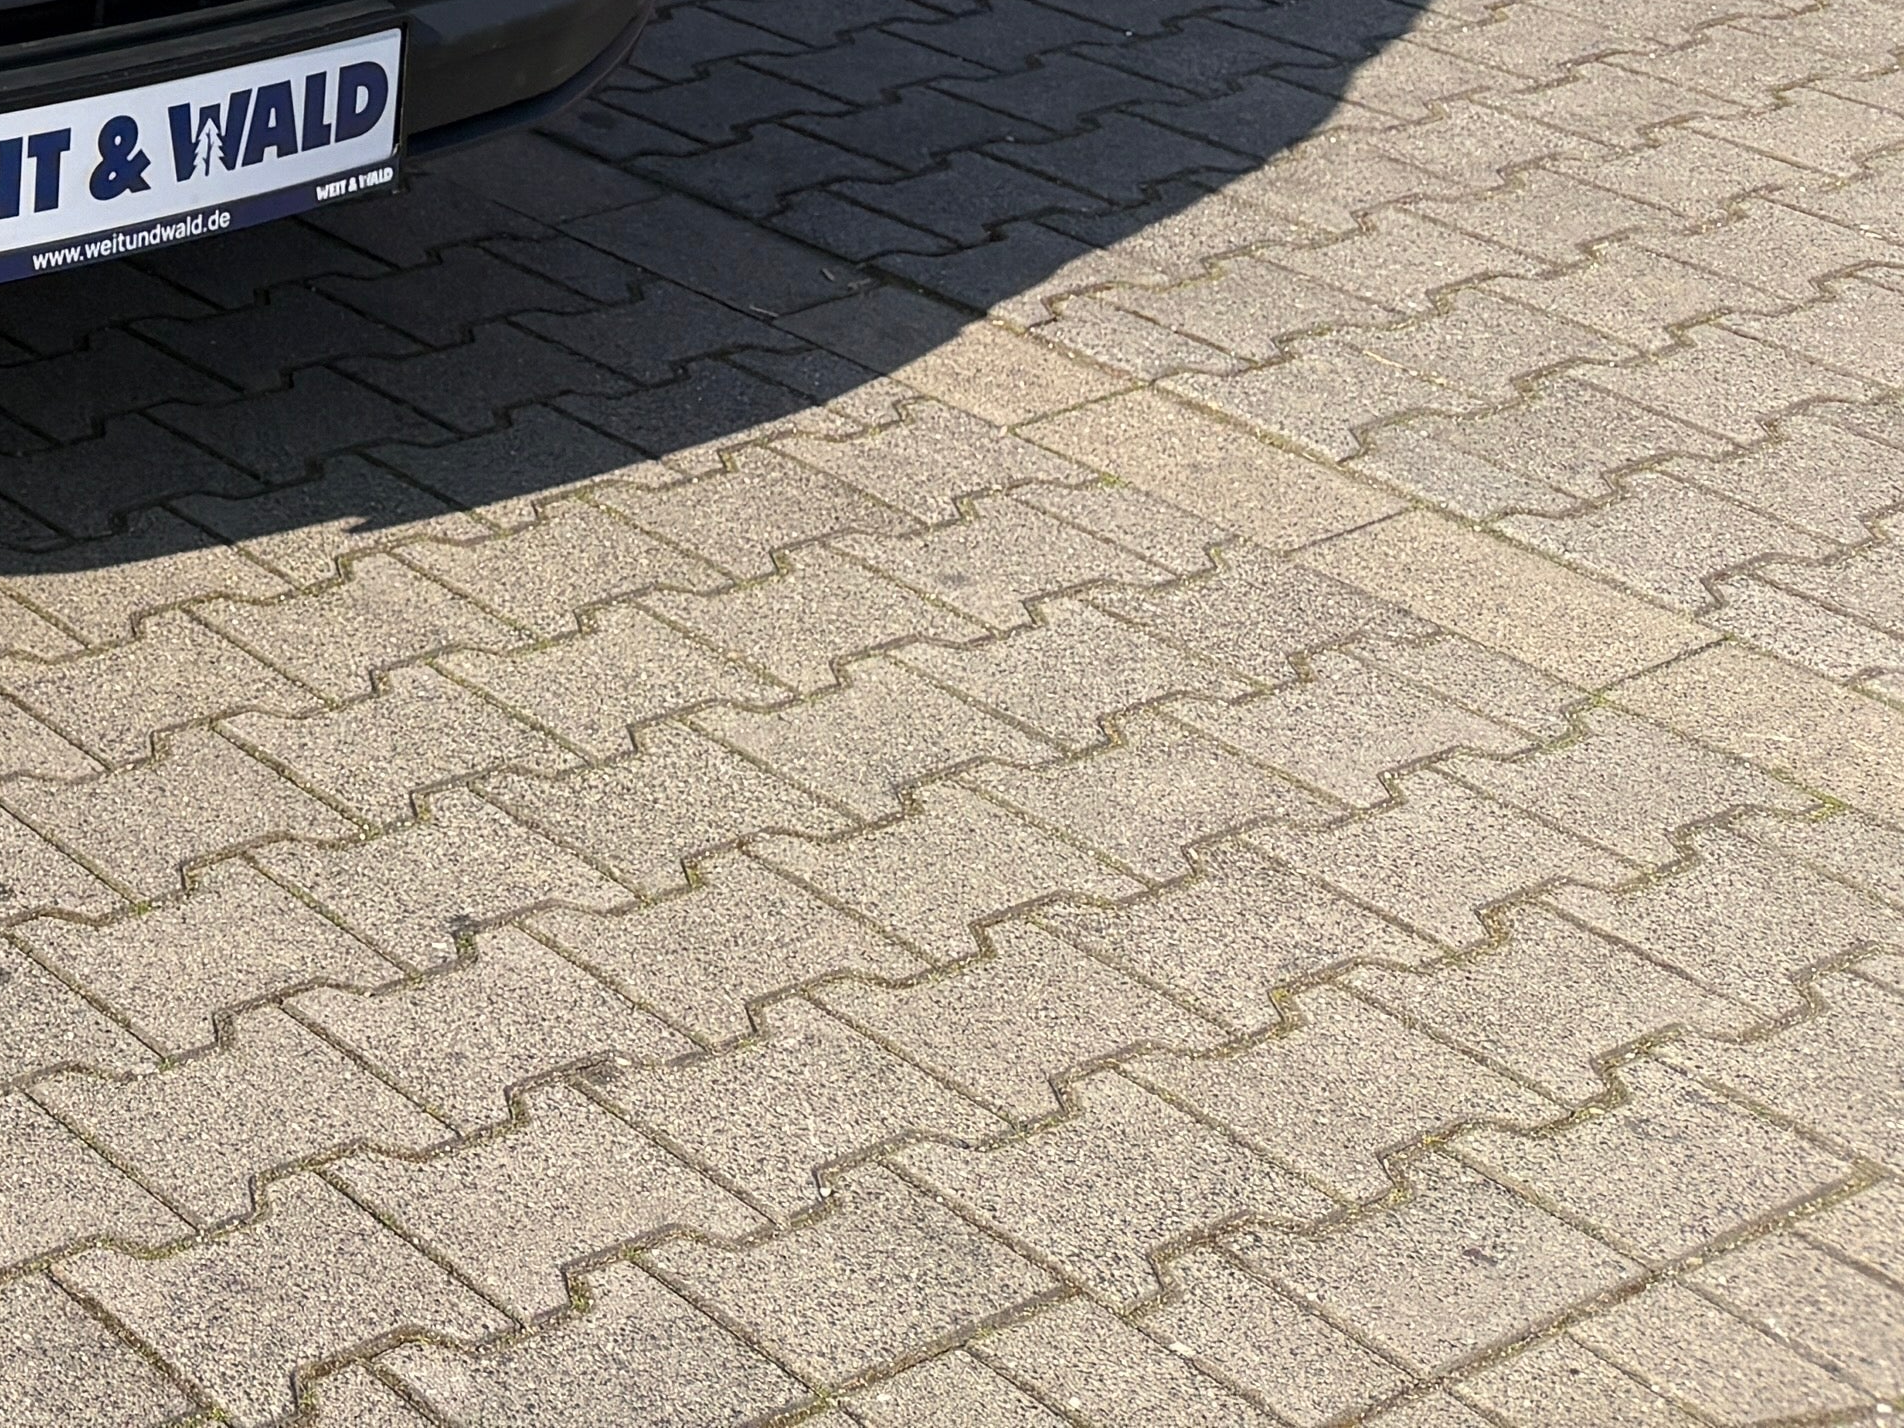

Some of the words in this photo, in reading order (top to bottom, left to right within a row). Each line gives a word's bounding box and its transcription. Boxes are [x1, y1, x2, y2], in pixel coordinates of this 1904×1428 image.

[89, 114, 152, 201] &
[168, 60, 389, 182] WALD
[316, 179, 347, 201] WEIT
[348, 177, 358, 192] &
[358, 167, 394, 189] WALD
[32, 210, 231, 270] www.weitundwald.de
